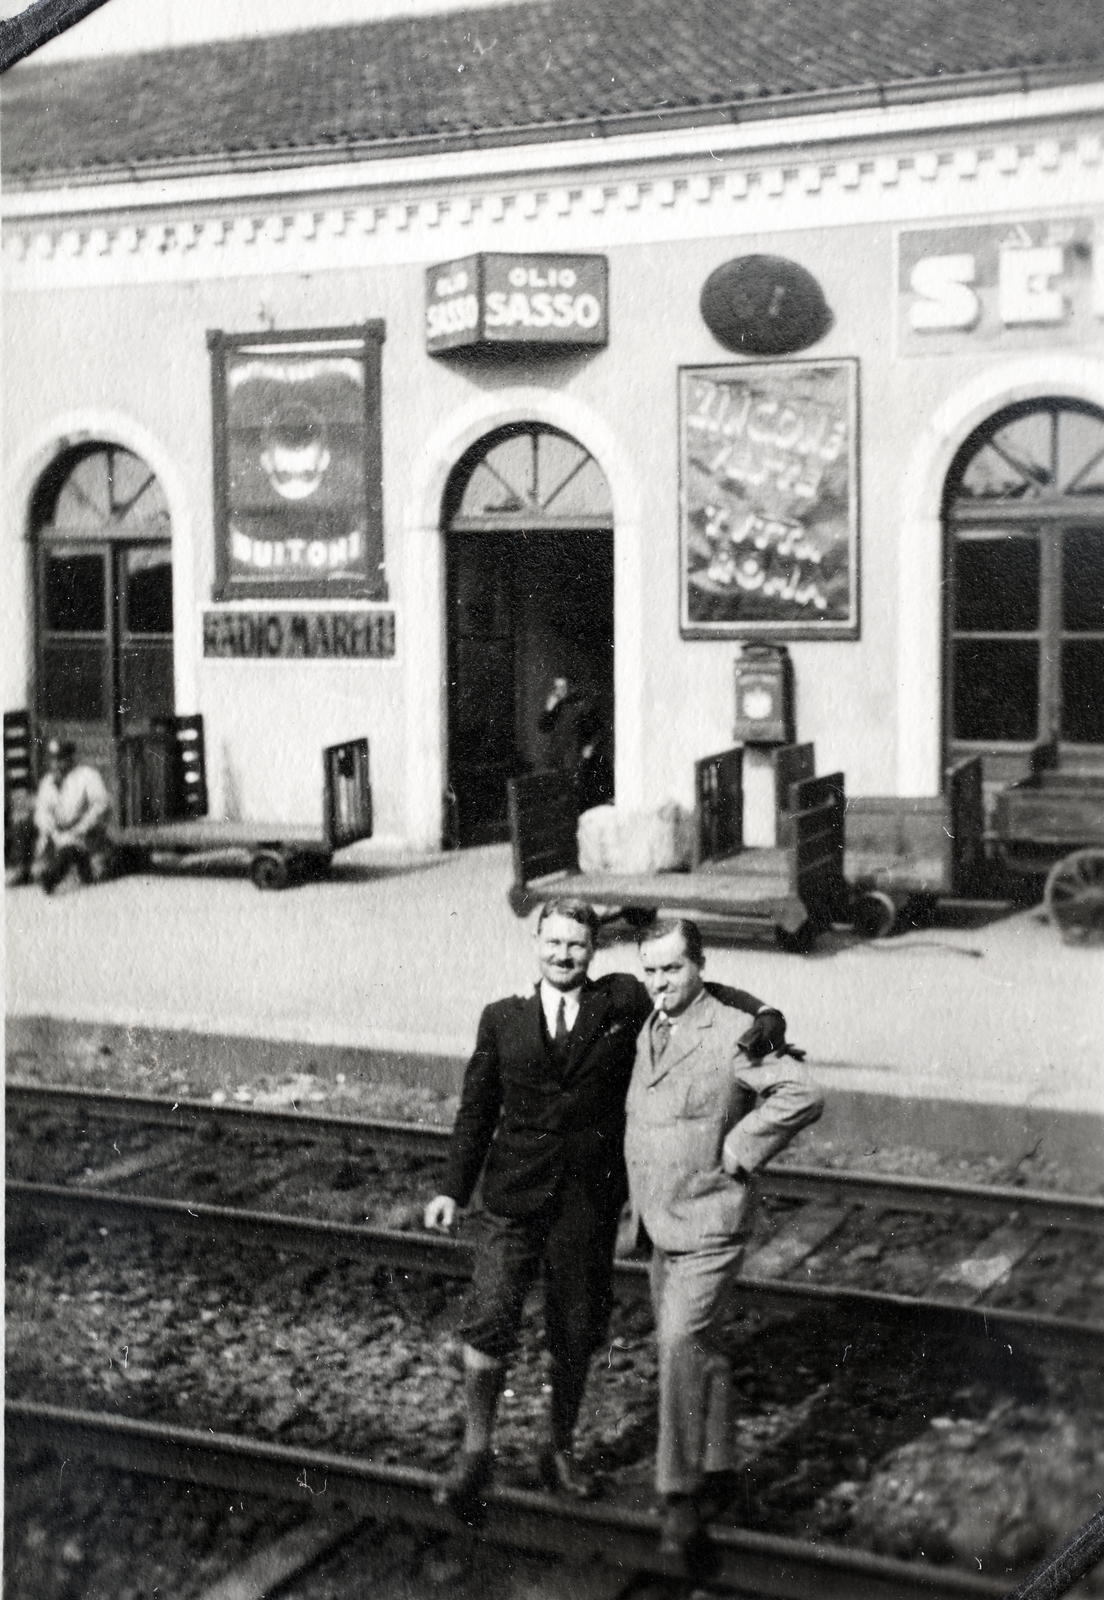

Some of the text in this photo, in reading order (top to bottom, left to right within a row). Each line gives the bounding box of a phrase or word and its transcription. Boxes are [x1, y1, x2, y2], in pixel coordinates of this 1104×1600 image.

[508, 267, 577, 288] OLIO
[909, 246, 1104, 330] SE
[485, 291, 601, 328] SASSO
